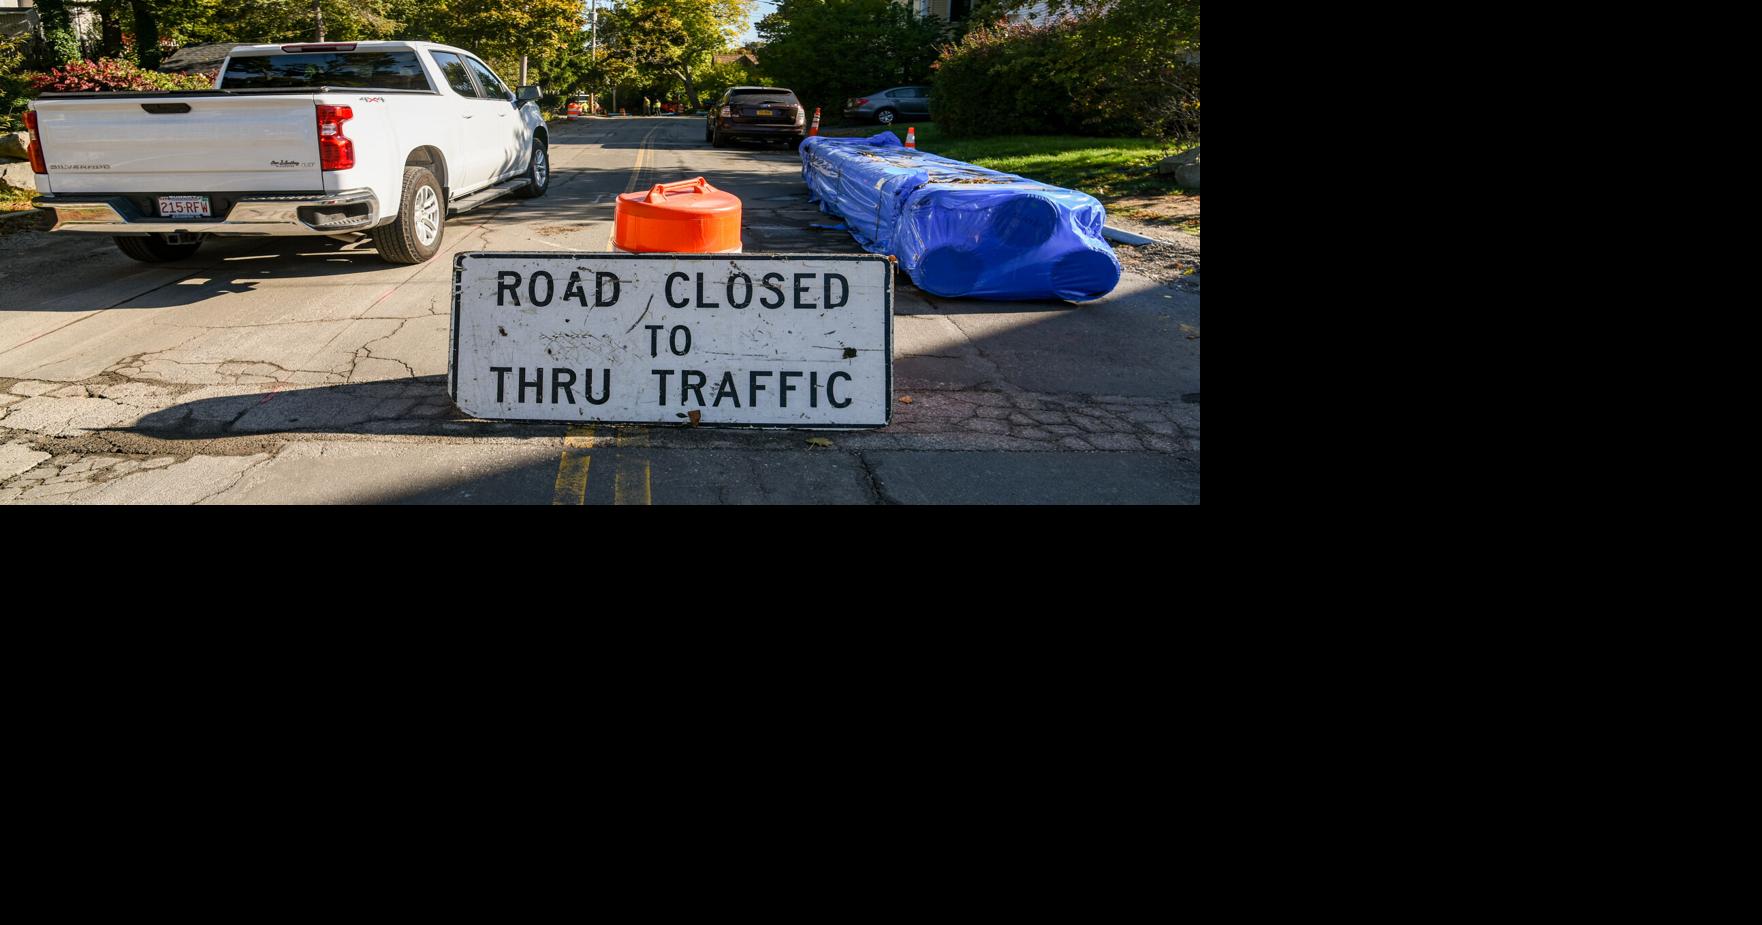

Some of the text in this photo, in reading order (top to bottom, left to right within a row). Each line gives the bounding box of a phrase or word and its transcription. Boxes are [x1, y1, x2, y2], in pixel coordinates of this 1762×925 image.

[496, 271, 850, 310] ROAD CLOSED
[644, 324, 692, 357] TO
[489, 366, 853, 409] THRU TRAFFIC
